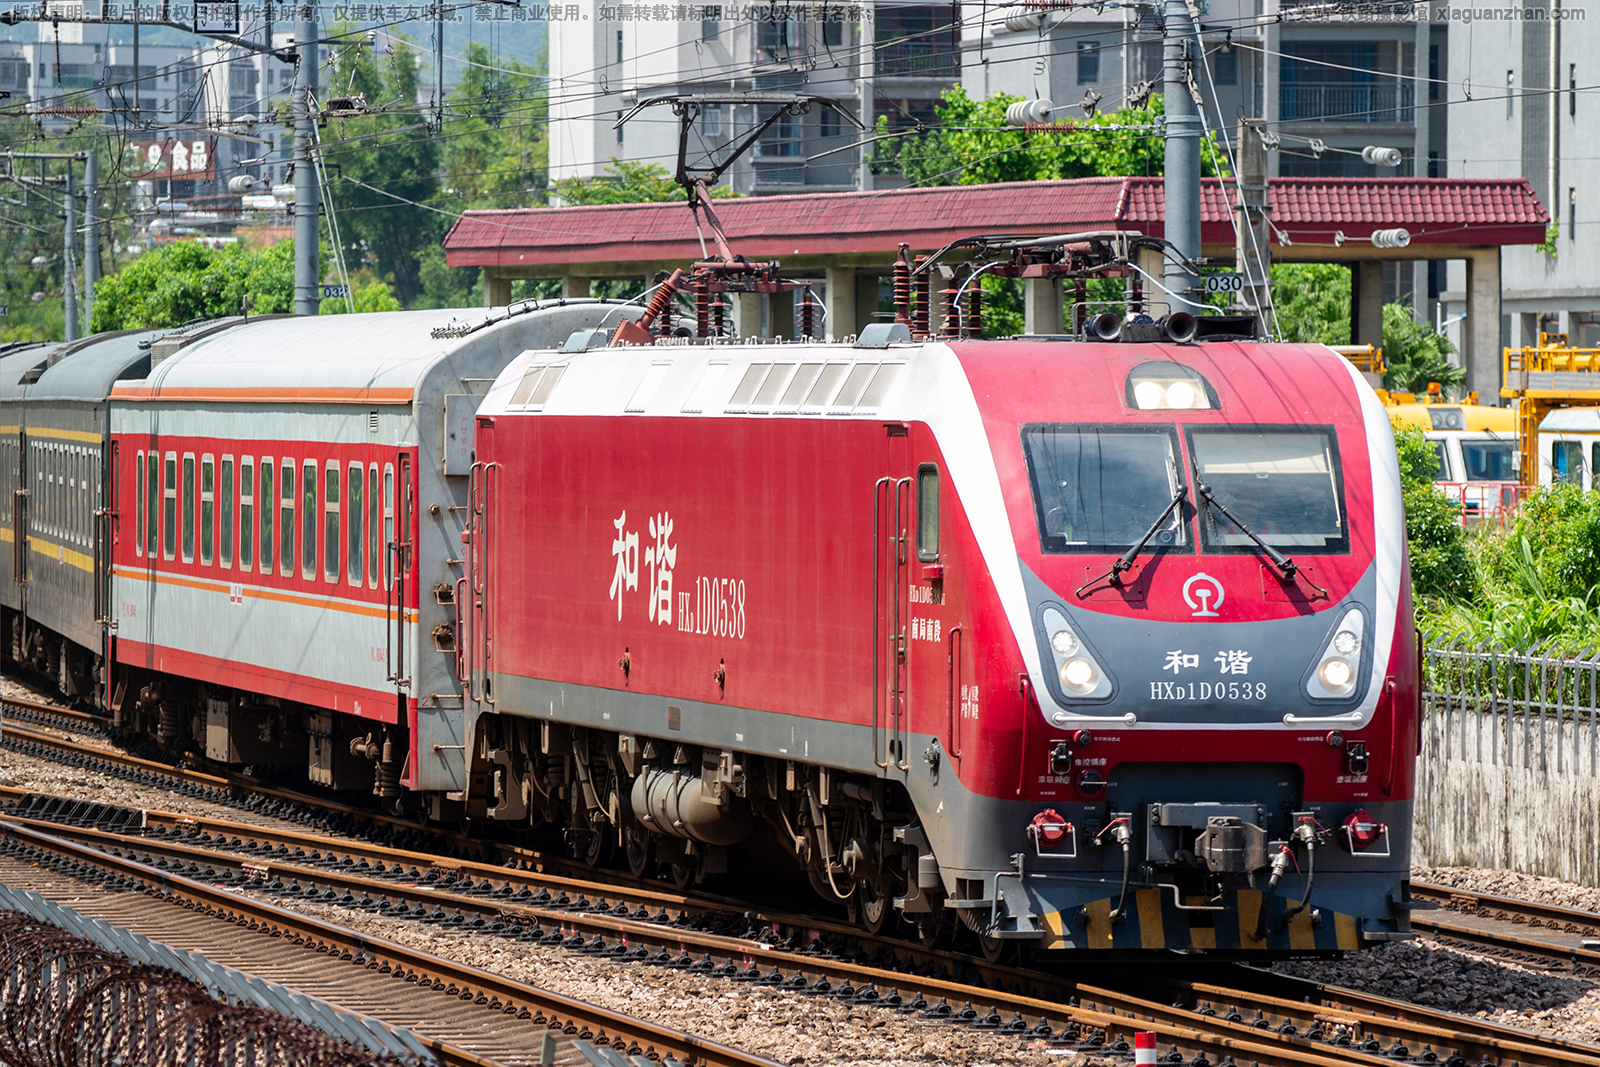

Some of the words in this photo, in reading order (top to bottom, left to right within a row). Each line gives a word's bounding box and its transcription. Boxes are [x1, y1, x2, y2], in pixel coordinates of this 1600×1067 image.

[173, 141, 208, 172] 食品
[324, 287, 348, 298] 032
[1208, 276, 1242, 291] 030
[609, 509, 678, 626] 和谐
[1162, 649, 1253, 675] 和谐
[1149, 681, 1267, 701] HXD1D0538
[421, 696, 430, 708] 2
